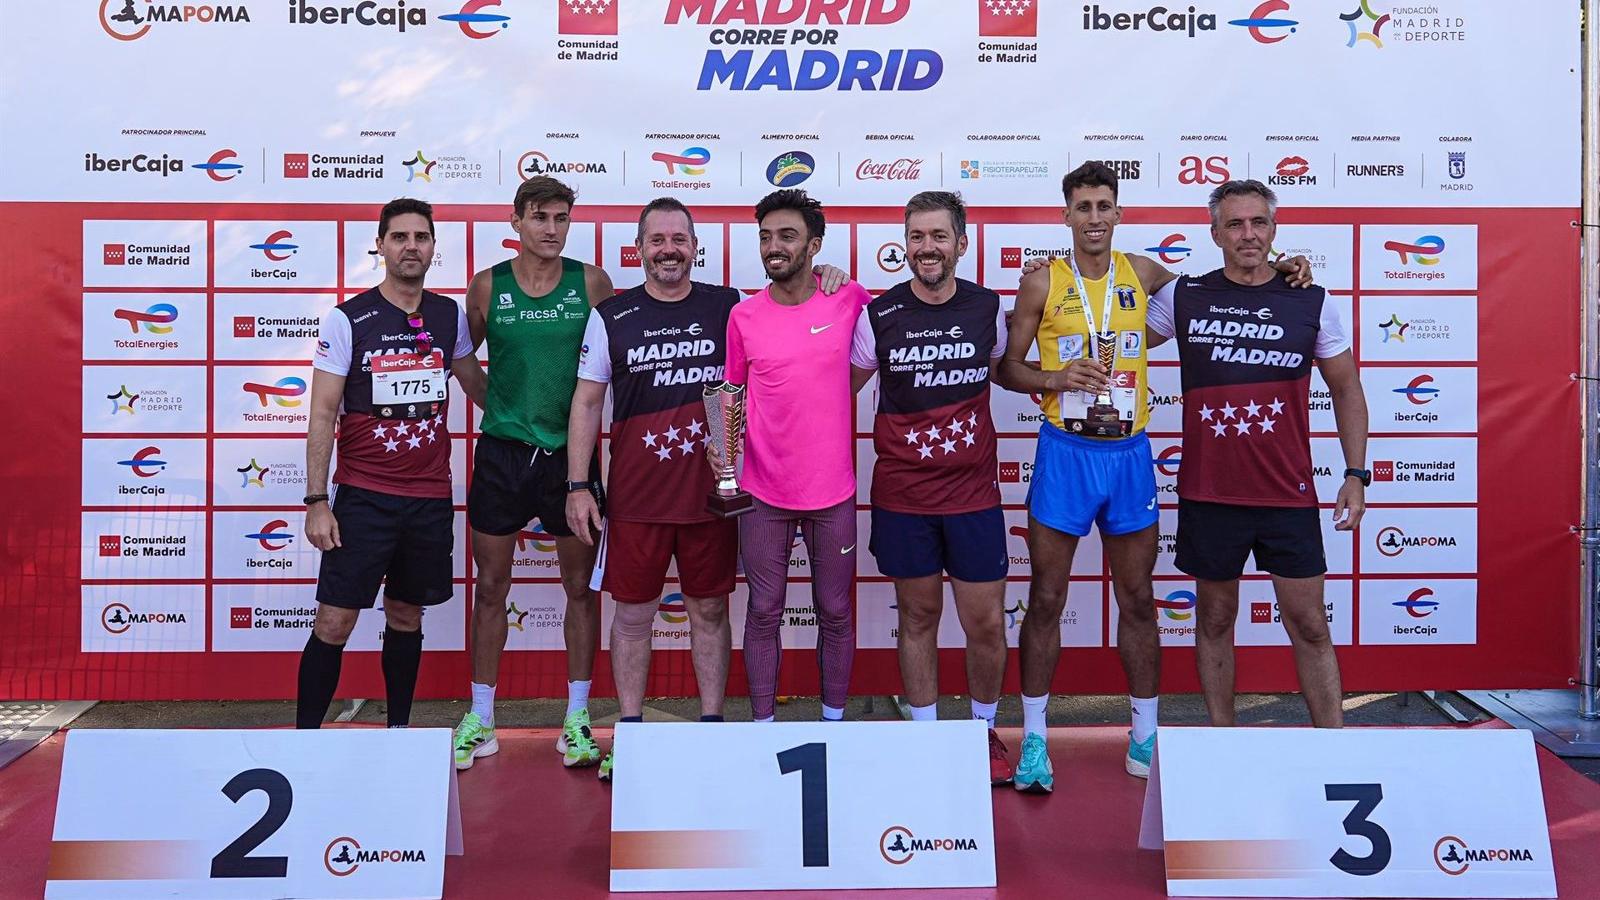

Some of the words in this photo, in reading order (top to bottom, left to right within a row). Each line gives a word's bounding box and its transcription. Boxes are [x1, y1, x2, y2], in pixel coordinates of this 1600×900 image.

[146, 5, 251, 23] MAPOMA
[664, 0, 911, 26] MADRID
[1392, 5, 1438, 14] FUNDACIÓN
[289, 0, 427, 33] iberCaja
[1083, 5, 1217, 38] iberCaja
[1393, 18, 1464, 28] MADRID
[709, 28, 788, 45] CORRE
[790, 29, 839, 45] POR
[1405, 31, 1465, 41] DEPORTE
[557, 39, 619, 50] Comunidad
[978, 42, 1038, 51] Comunidad
[557, 51, 573, 61] de
[576, 51, 618, 61] Madrid
[978, 53, 993, 63] de
[996, 53, 1037, 63] Madrid
[696, 49, 944, 91] MADRID
[1084, 133, 1119, 141] NUTRICIÓN
[85, 153, 184, 177] iberCaja
[312, 154, 384, 165] Comunidad
[438, 163, 482, 171] MADRID
[545, 163, 607, 174] MAPOMA
[1178, 156, 1231, 184] as
[1347, 164, 1404, 177] RUNNER'S
[312, 167, 330, 179] de
[334, 167, 384, 179] Madrid
[445, 171, 482, 179] DEPORTE
[652, 181, 711, 190] TotalEnergies
[1268, 175, 1296, 186] KISS
[1298, 175, 1317, 186] FM
[128, 244, 190, 253] Comunidad
[1024, 248, 1071, 256] Comunid
[128, 255, 143, 266] de
[147, 255, 190, 266] Madrid
[251, 268, 297, 280] iberCaja
[1384, 271, 1445, 281] TotalEnergies
[1209, 305, 1250, 317] iberCaja
[258, 316, 319, 326] Comunidad
[258, 328, 273, 338] de
[277, 328, 319, 338] Madrid
[644, 326, 681, 338] iberCaja
[906, 328, 943, 339] iberCaja
[1188, 319, 1285, 340] MADRID
[114, 339, 179, 350] TotalEnergies
[1188, 336, 1213, 344] CORRE
[1214, 337, 1235, 346] POR
[627, 339, 716, 366] MADRID
[889, 342, 976, 363] MADRID
[1211, 345, 1304, 368] MADRID
[380, 359, 416, 368] iberCaja
[629, 363, 654, 373] CORRE
[655, 361, 673, 369] POR
[890, 364, 914, 372] CORRE
[915, 363, 934, 371] POR
[914, 366, 989, 388] MADRID
[391, 380, 431, 396] 1775
[243, 412, 307, 423] TotalEnergies
[1017, 412, 1045, 422] iberC
[1394, 412, 1438, 423] iberCaja
[1396, 461, 1455, 470] Comunidad
[1396, 472, 1411, 482] de
[1414, 472, 1455, 482] Madrid
[118, 485, 165, 496] iberCaja
[123, 535, 186, 545] Comunidad
[1401, 536, 1457, 547] MAPOMA
[123, 547, 139, 557] de
[143, 547, 186, 557] Madrid
[246, 558, 293, 570] iberCaja
[254, 607, 317, 617] Comunidad
[128, 613, 187, 624] MAPOMA
[254, 619, 270, 629] de
[1393, 625, 1438, 636] iberCaja
[776, 742, 829, 867] 1
[210, 768, 294, 878] 2
[1324, 783, 1392, 876] 3
[910, 838, 978, 851] MAPOMA
[355, 850, 426, 863] MAPOMA
[1465, 848, 1533, 862] MAPOMA
